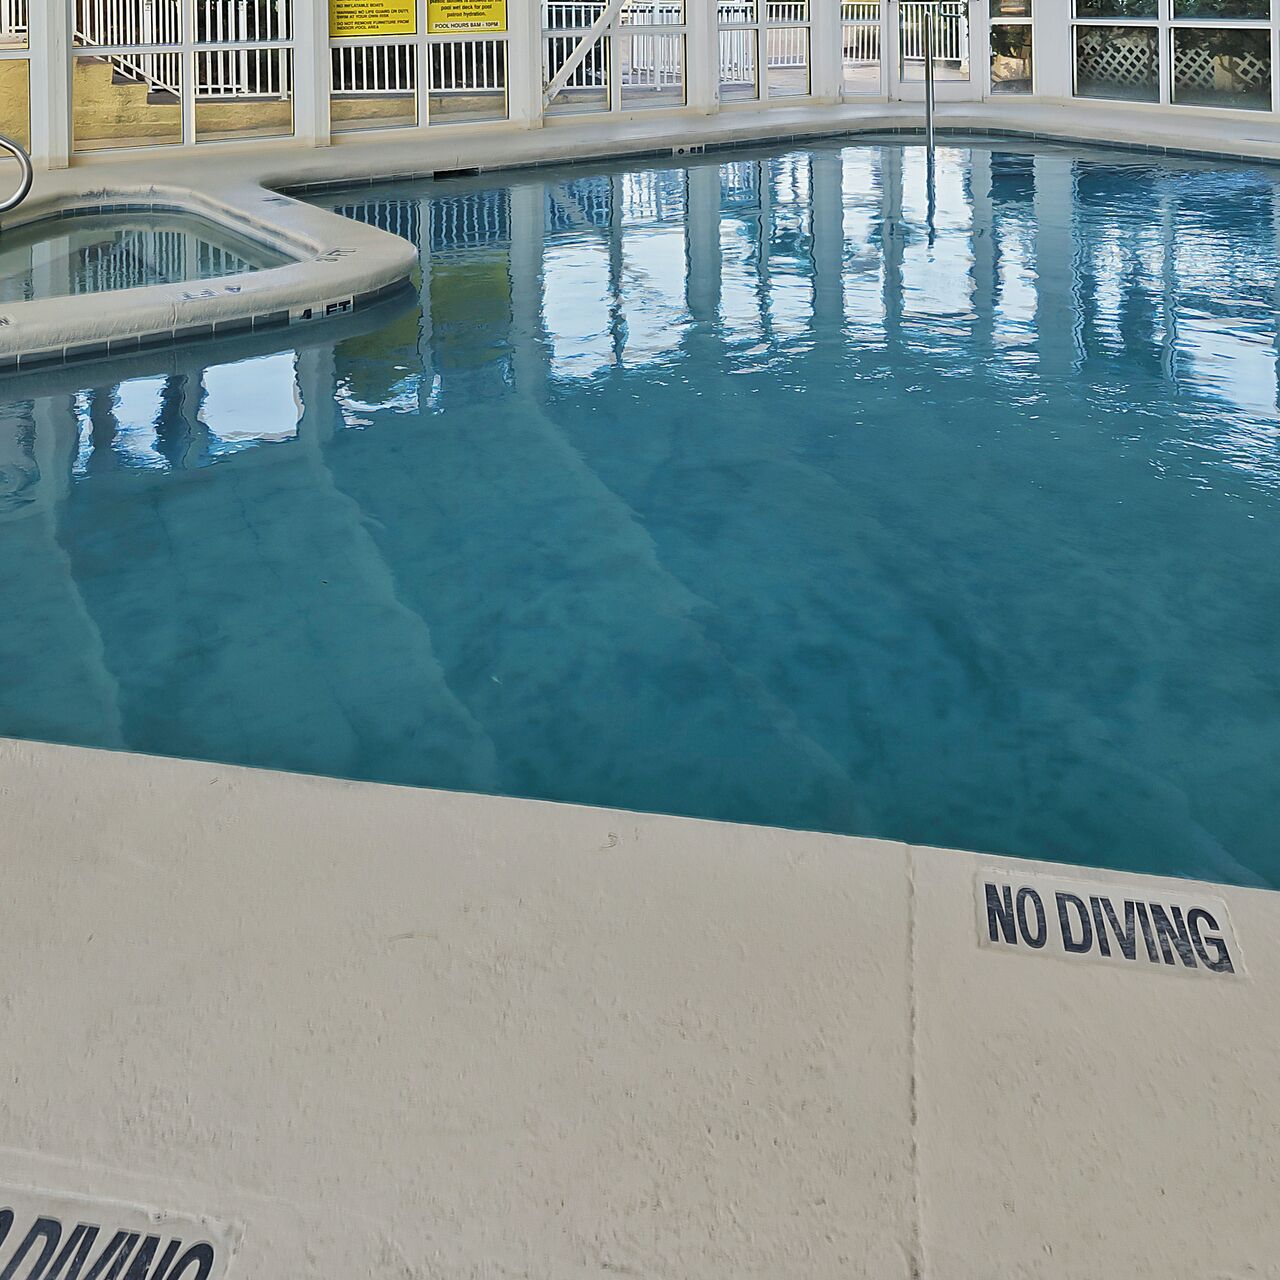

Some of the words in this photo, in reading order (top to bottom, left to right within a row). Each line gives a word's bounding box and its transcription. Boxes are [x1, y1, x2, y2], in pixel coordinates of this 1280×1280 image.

[299, 308, 312, 320] 4
[326, 300, 351, 315] FT
[984, 883, 1047, 949] NO
[1055, 890, 1235, 974] DIVING
